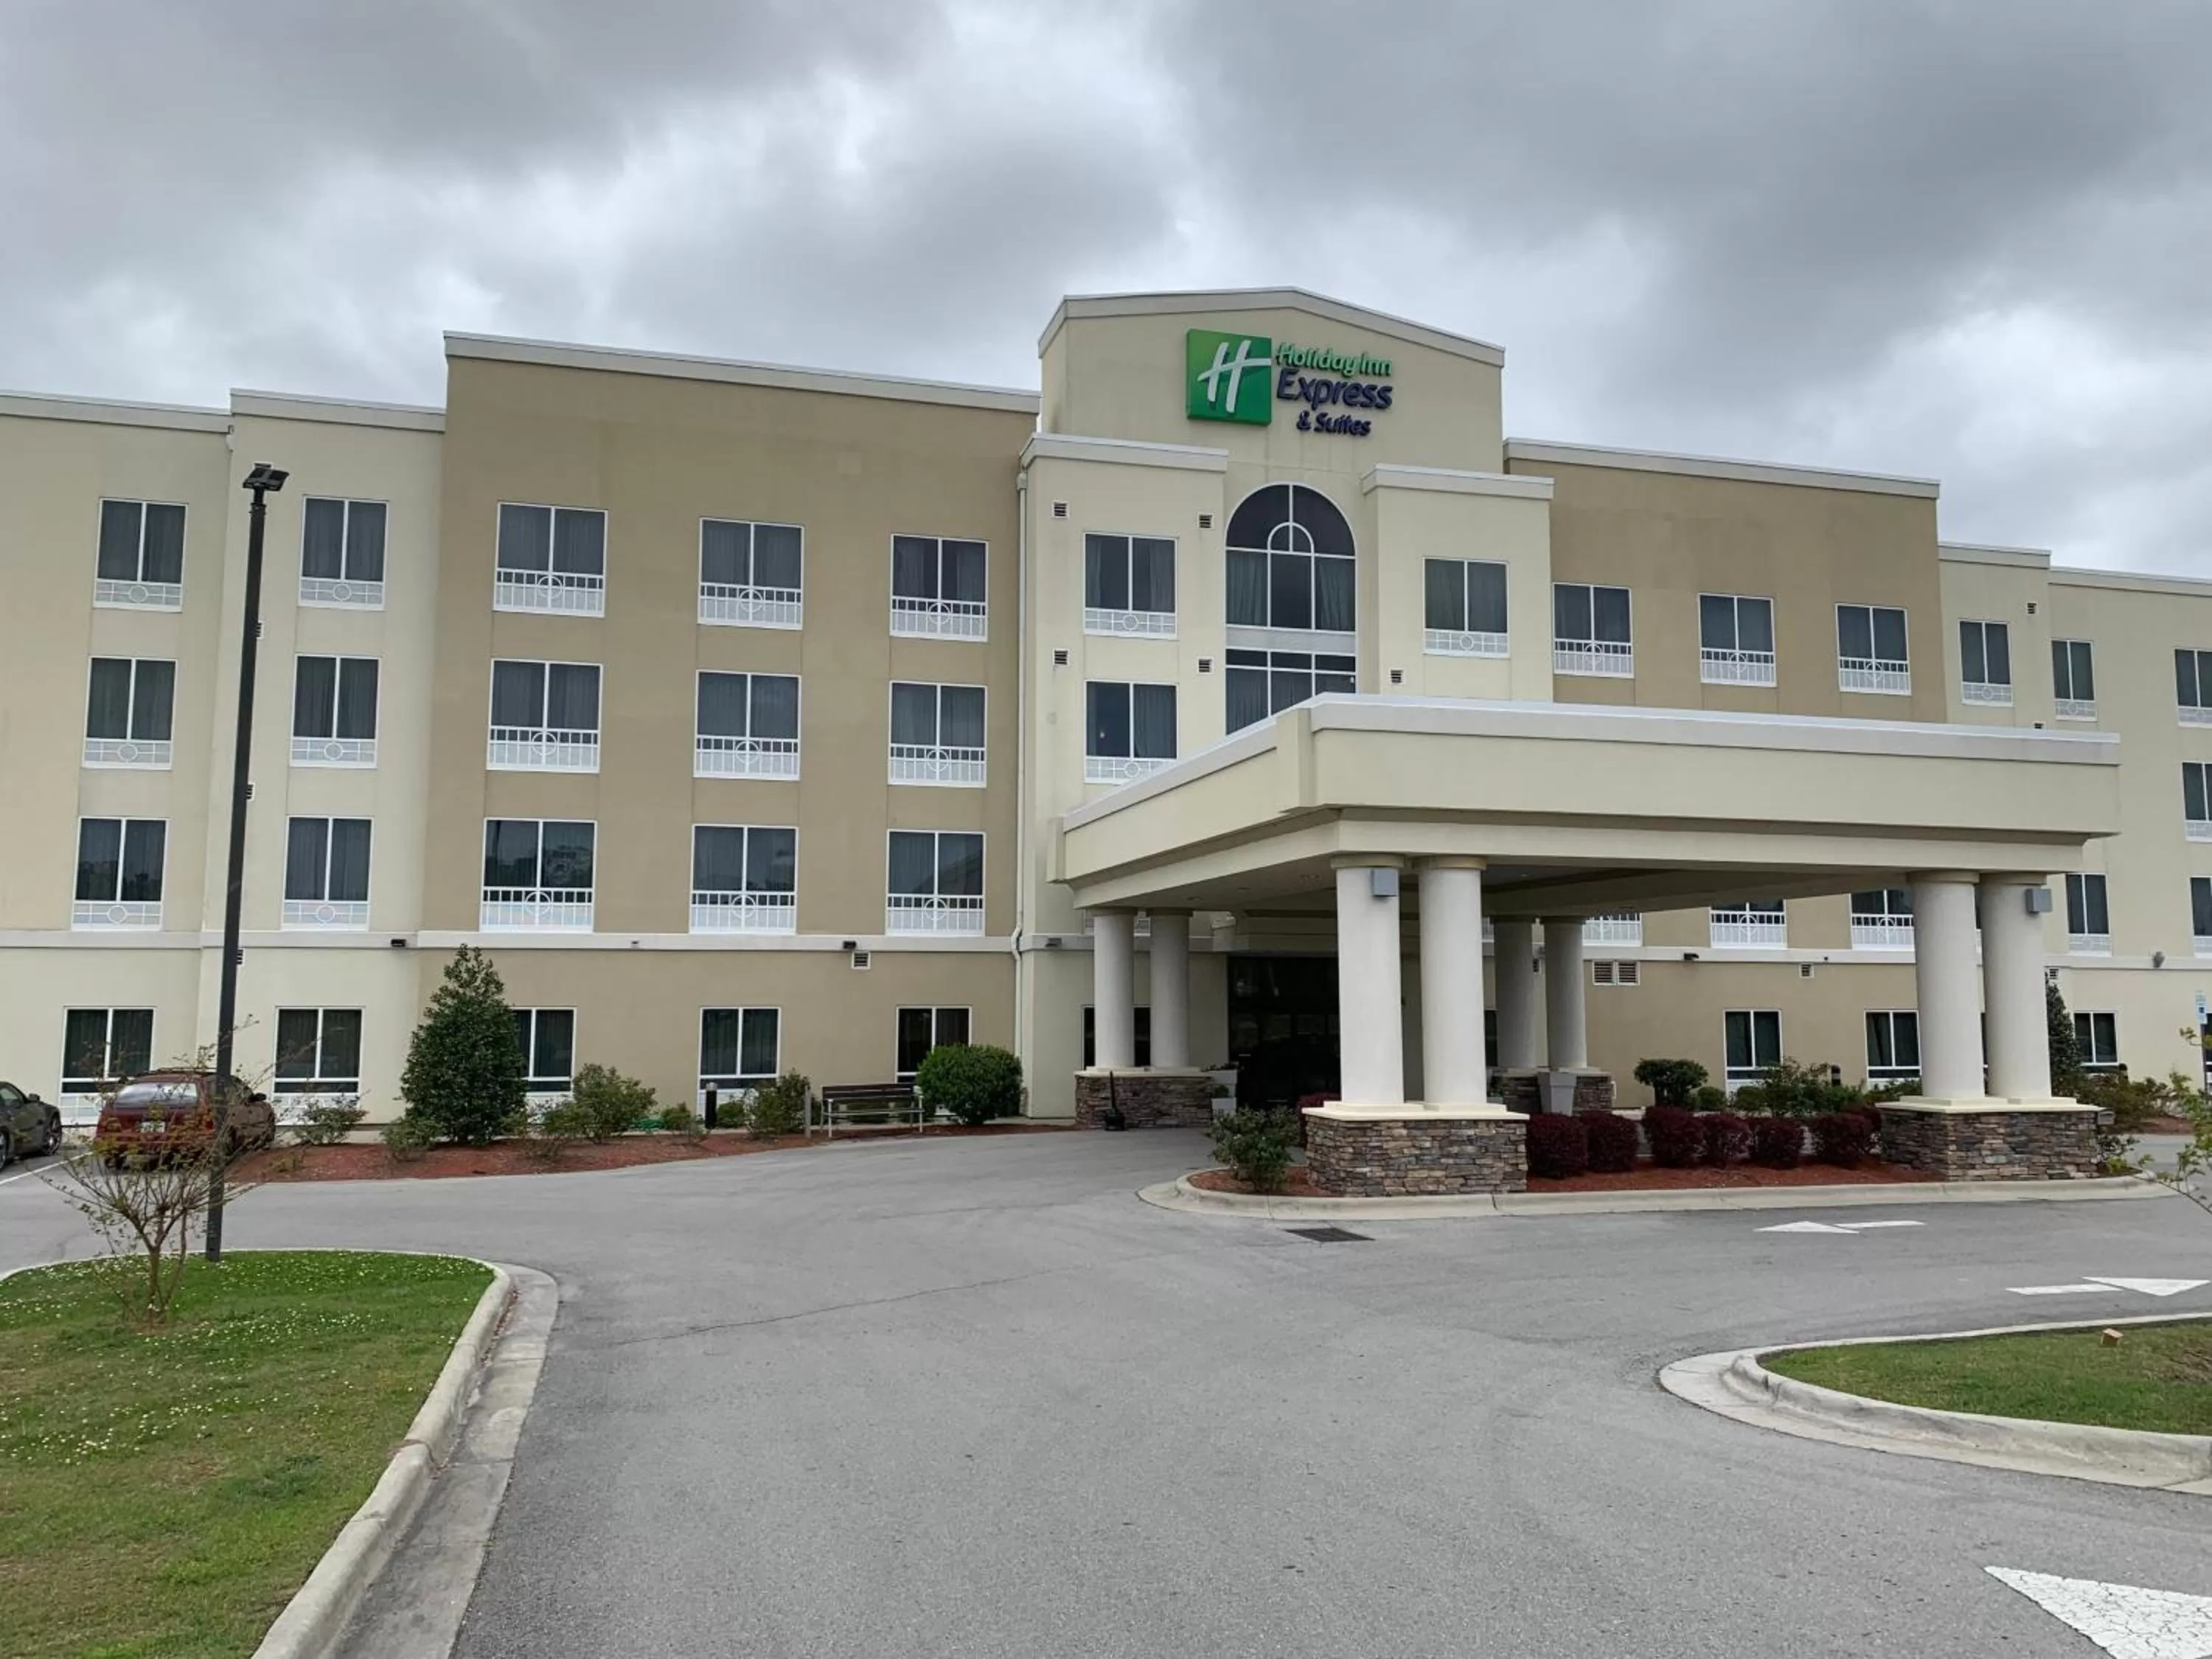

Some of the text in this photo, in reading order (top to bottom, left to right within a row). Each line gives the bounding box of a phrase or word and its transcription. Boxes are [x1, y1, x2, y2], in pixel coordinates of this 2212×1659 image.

[1276, 342, 1393, 378] Holiday Inn
[1276, 368, 1394, 411] Express
[1295, 409, 1372, 437] & Suites
